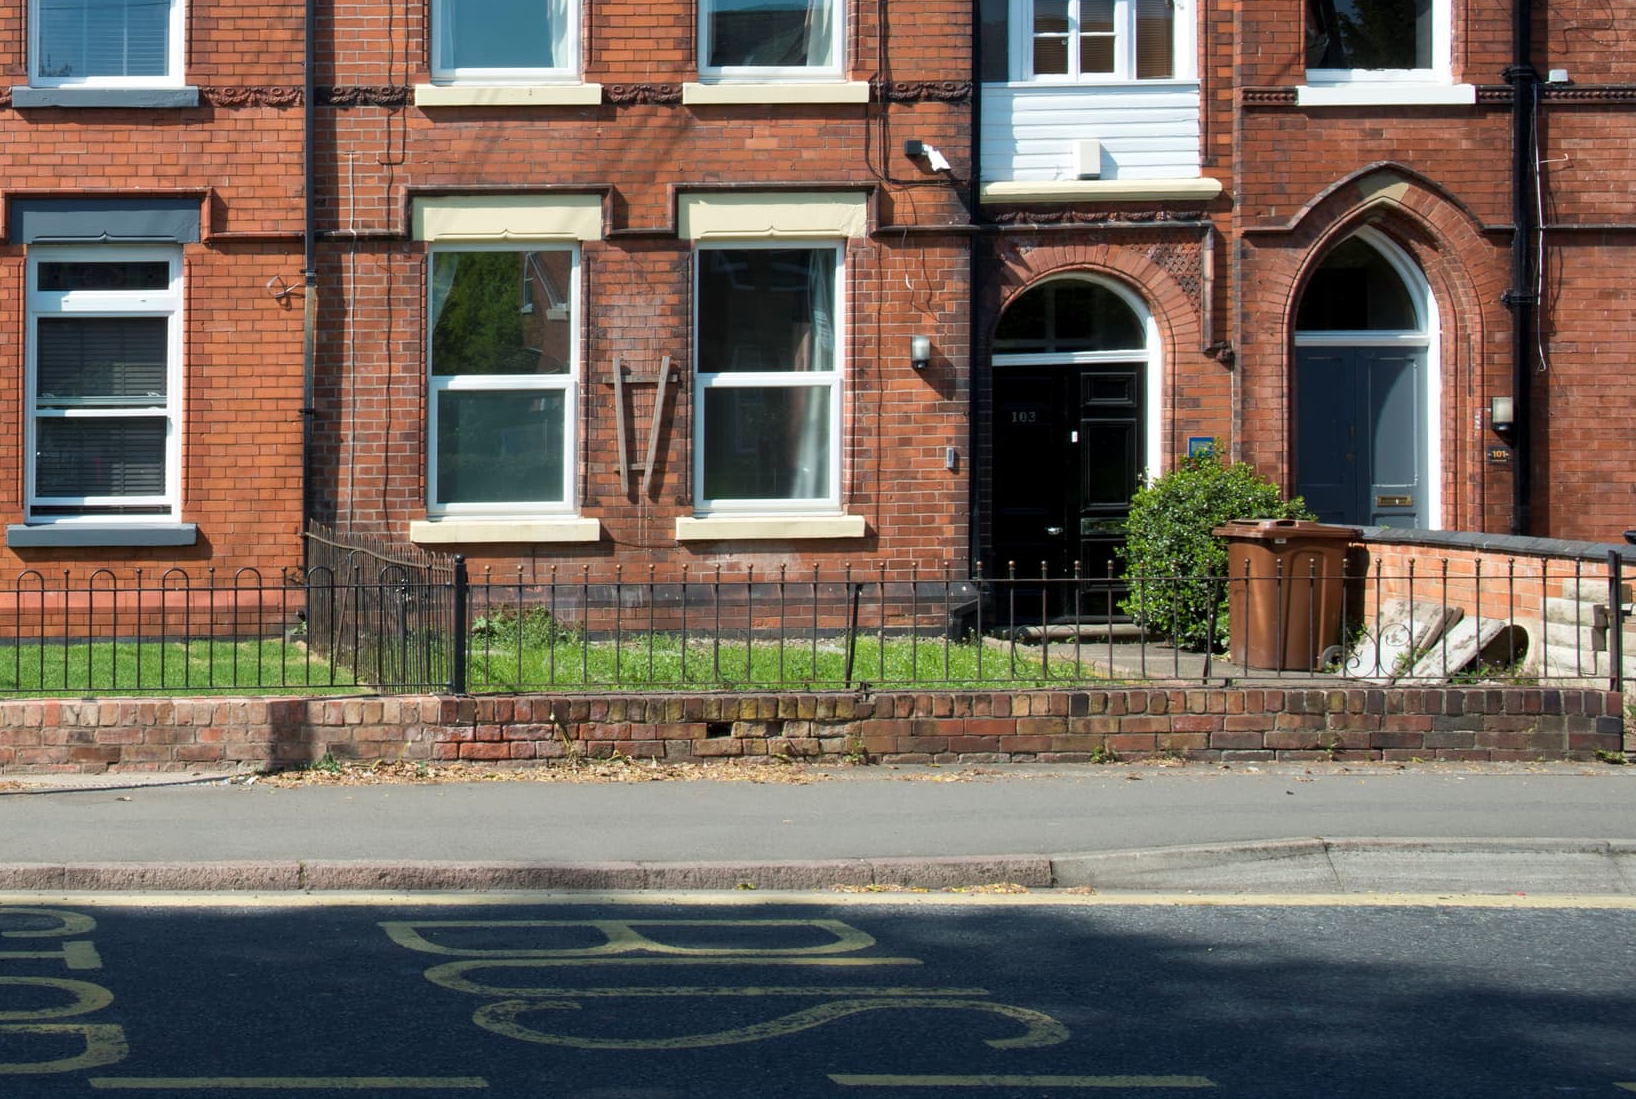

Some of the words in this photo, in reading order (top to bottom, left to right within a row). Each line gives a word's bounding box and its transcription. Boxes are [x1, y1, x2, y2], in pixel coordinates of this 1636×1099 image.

[1012, 411, 1036, 423] 103
[1492, 450, 1506, 458] 101
[377, 919, 1070, 1049] BUS
